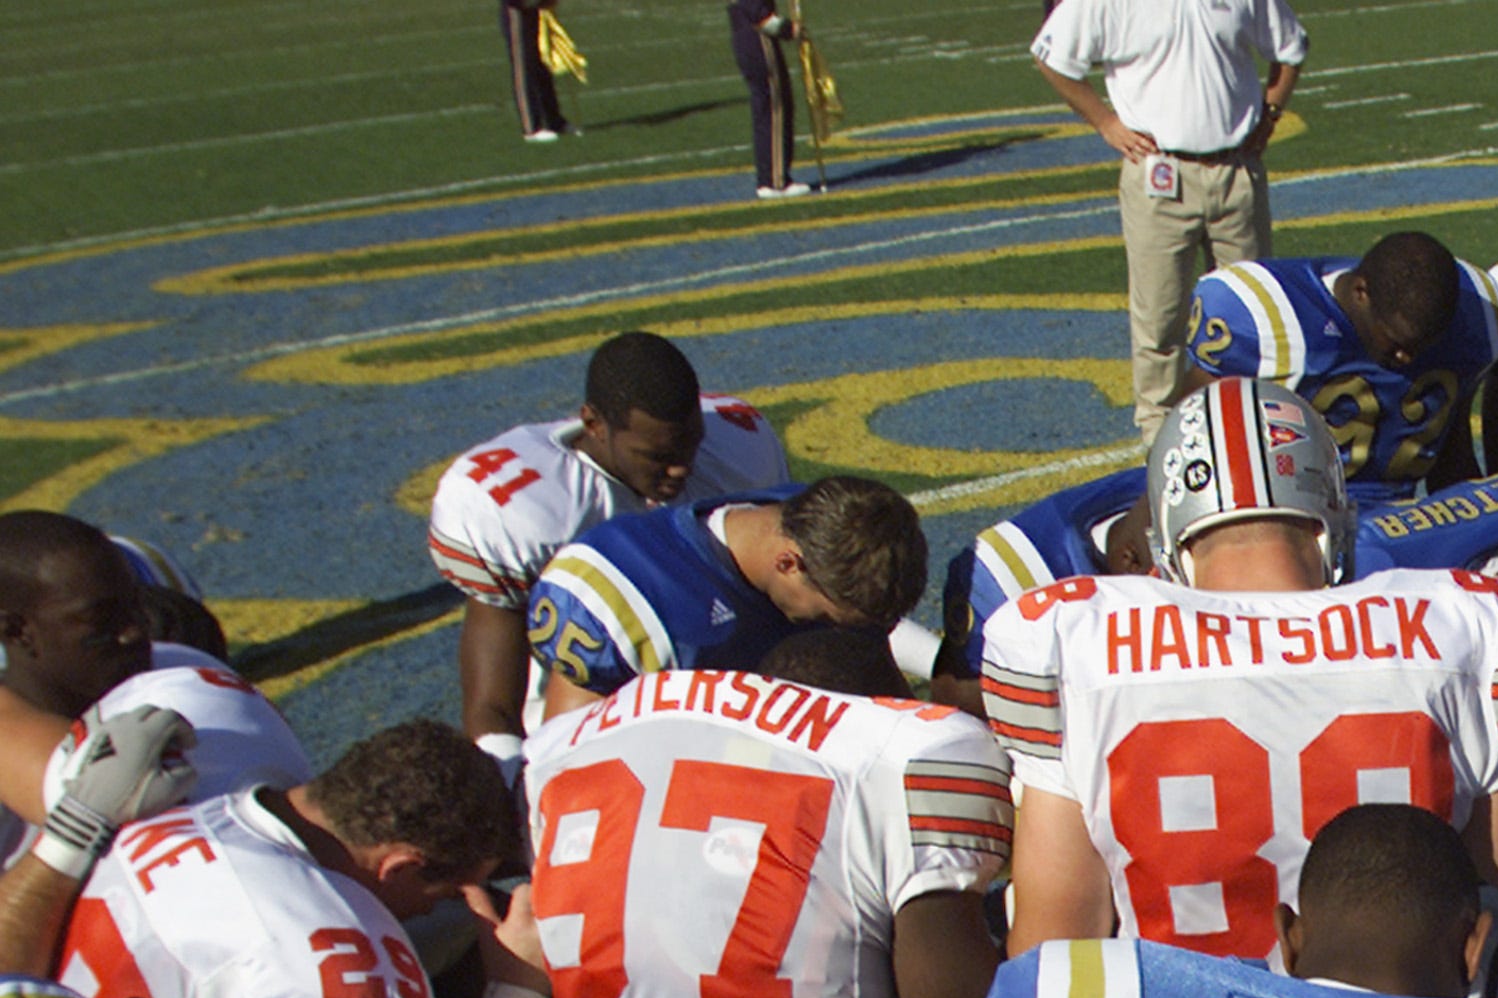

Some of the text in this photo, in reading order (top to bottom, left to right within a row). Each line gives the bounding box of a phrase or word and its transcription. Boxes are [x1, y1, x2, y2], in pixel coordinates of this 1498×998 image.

[466, 447, 543, 507] 41
[527, 596, 602, 686] 25
[1106, 596, 1443, 675] HARTSOCK
